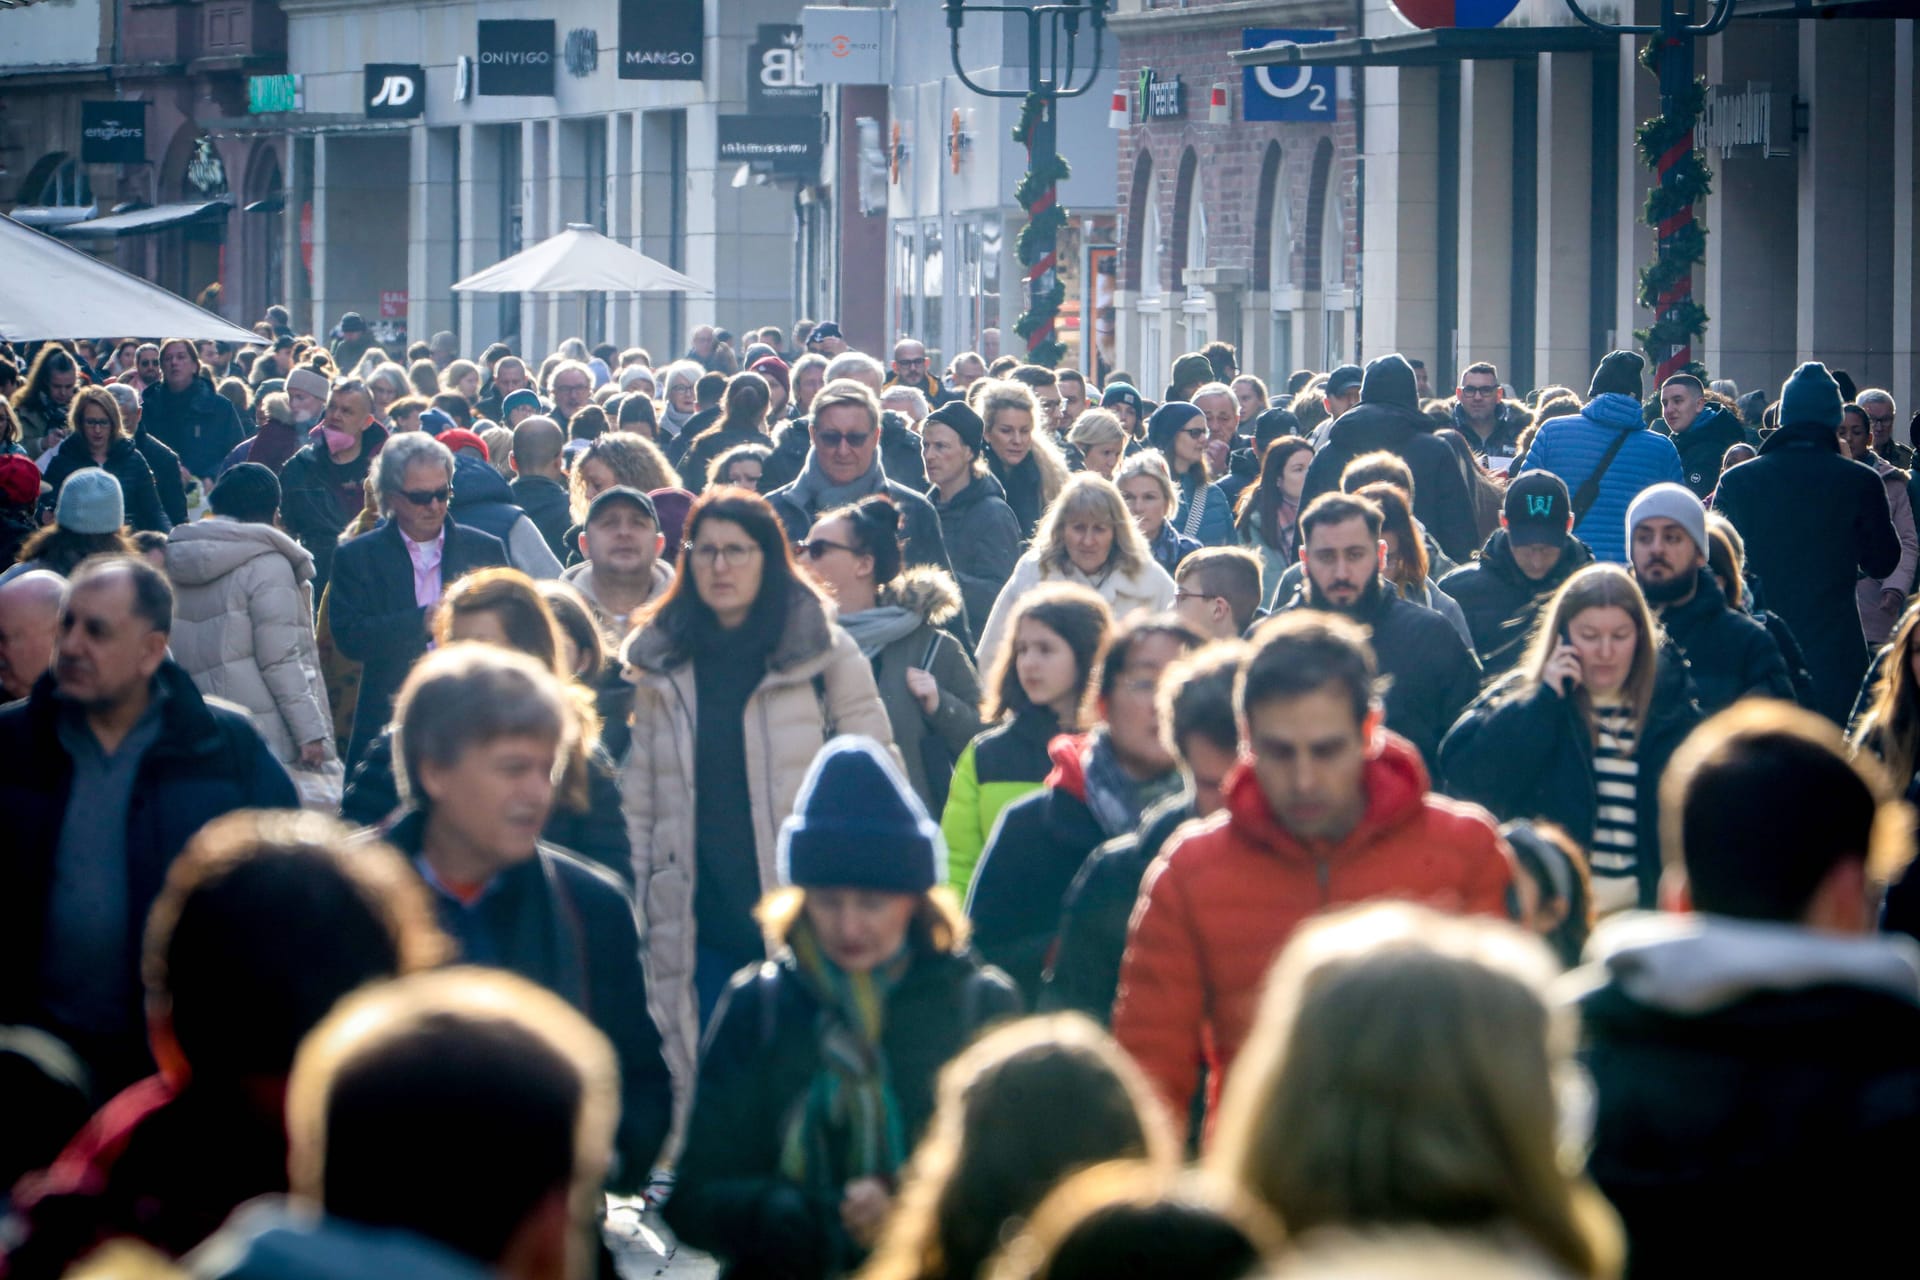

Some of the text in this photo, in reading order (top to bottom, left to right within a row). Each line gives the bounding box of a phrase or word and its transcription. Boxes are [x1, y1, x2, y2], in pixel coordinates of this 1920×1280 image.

[626, 51, 695, 65] MANGO
[371, 76, 413, 107] JD
[383, 292, 408, 303] SAL
